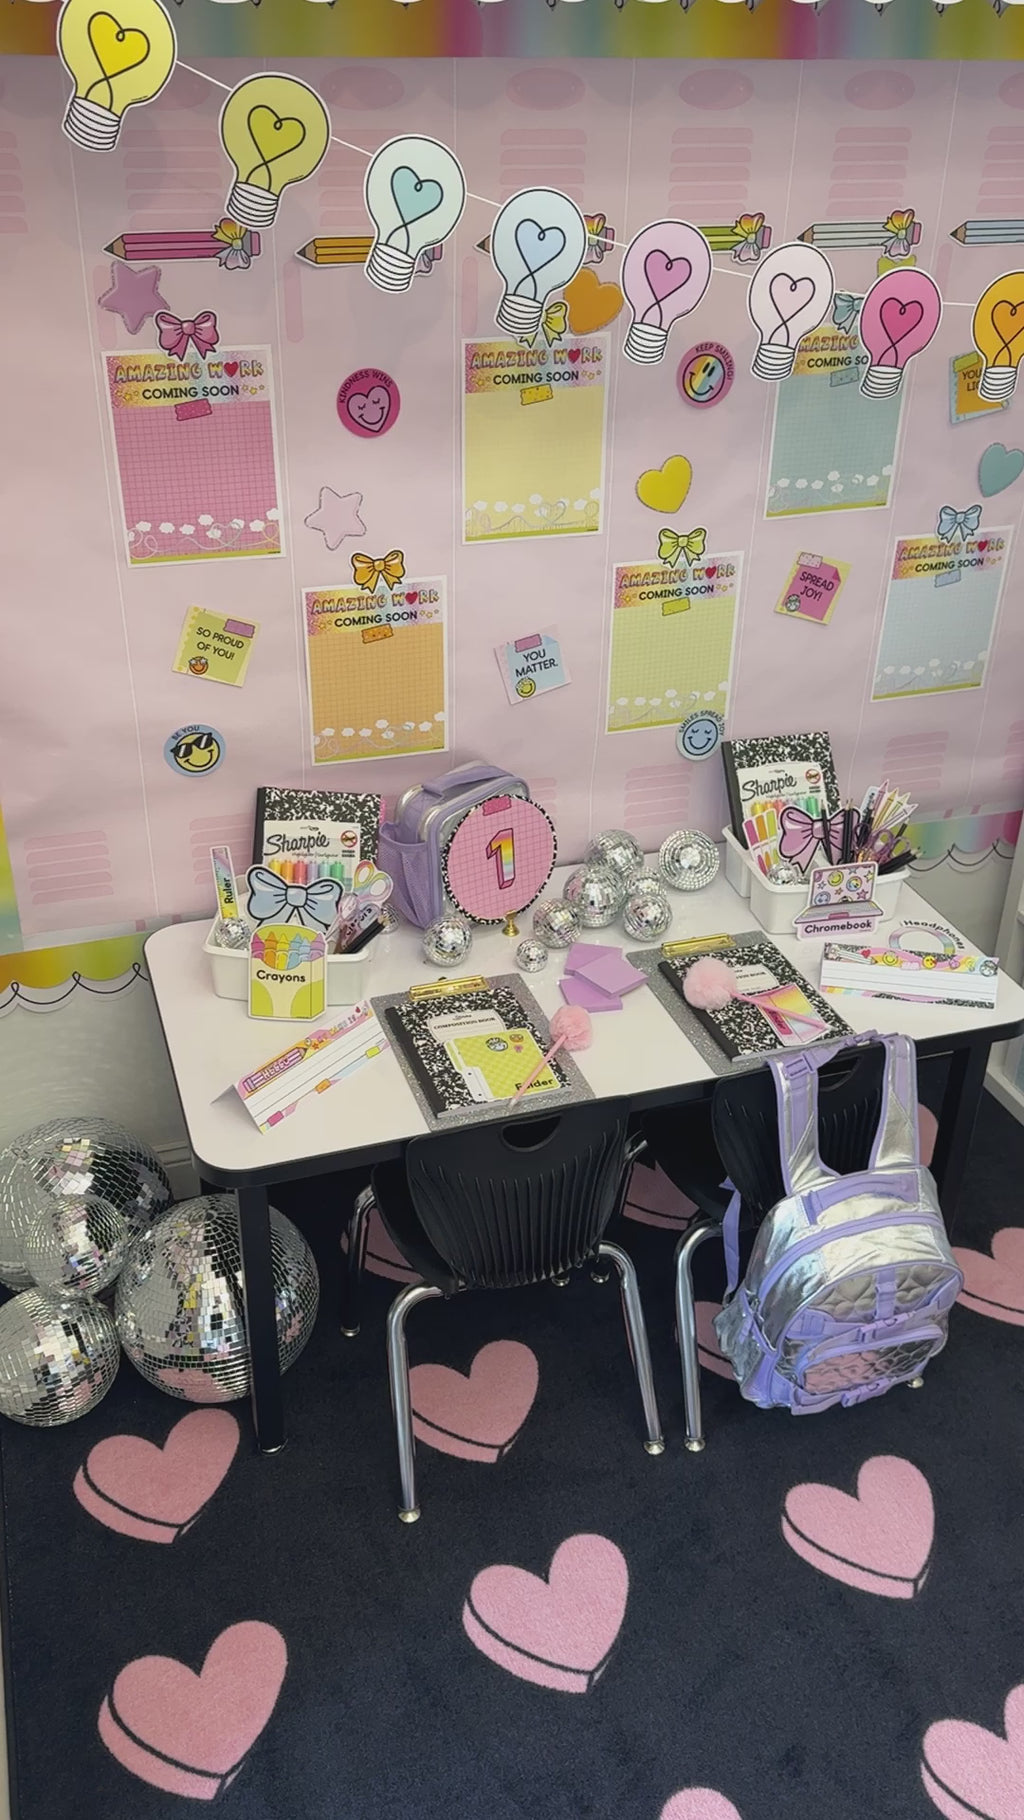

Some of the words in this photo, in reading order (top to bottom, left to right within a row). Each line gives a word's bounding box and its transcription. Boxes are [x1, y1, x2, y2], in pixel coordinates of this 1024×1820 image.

[695, 342, 714, 353] KEEP
[798, 334, 859, 353] MAZING
[469, 349, 548, 370] AMAZING
[807, 357, 851, 368] COMING
[853, 355, 869, 366] SO
[114, 362, 202, 384] AMAZING
[493, 372, 543, 385] COMING
[546, 370, 579, 383] SOON
[142, 386, 199, 400] COMING
[202, 385, 240, 398] SOON
[339, 370, 370, 403] KINDNESS
[915, 561, 956, 573] COMING
[957, 558, 984, 569] SOON
[618, 568, 688, 589] AMAZING
[799, 571, 835, 592] SPREAD
[638, 588, 683, 601] COMING
[685, 585, 715, 596] SOON
[800, 586, 823, 602] JOY!
[311, 595, 388, 615] AMAZING
[334, 613, 383, 628] COMING
[385, 610, 418, 623] SOON
[196, 626, 211, 638] SO
[212, 632, 244, 649] PROUD
[196, 641, 212, 652] OF
[212, 645, 236, 661] YOU!
[523, 648, 546, 662] YOU
[182, 725, 200, 734] YOU
[742, 773, 797, 802] Sharpie
[263, 831, 330, 856] Sharpie
[486, 827, 516, 890] 1
[223, 877, 234, 904] Ruler
[804, 919, 872, 934] Chromebook
[903, 920, 965, 949] Headphones
[256, 969, 306, 984] Crayons
[515, 1079, 553, 1091] Flder
